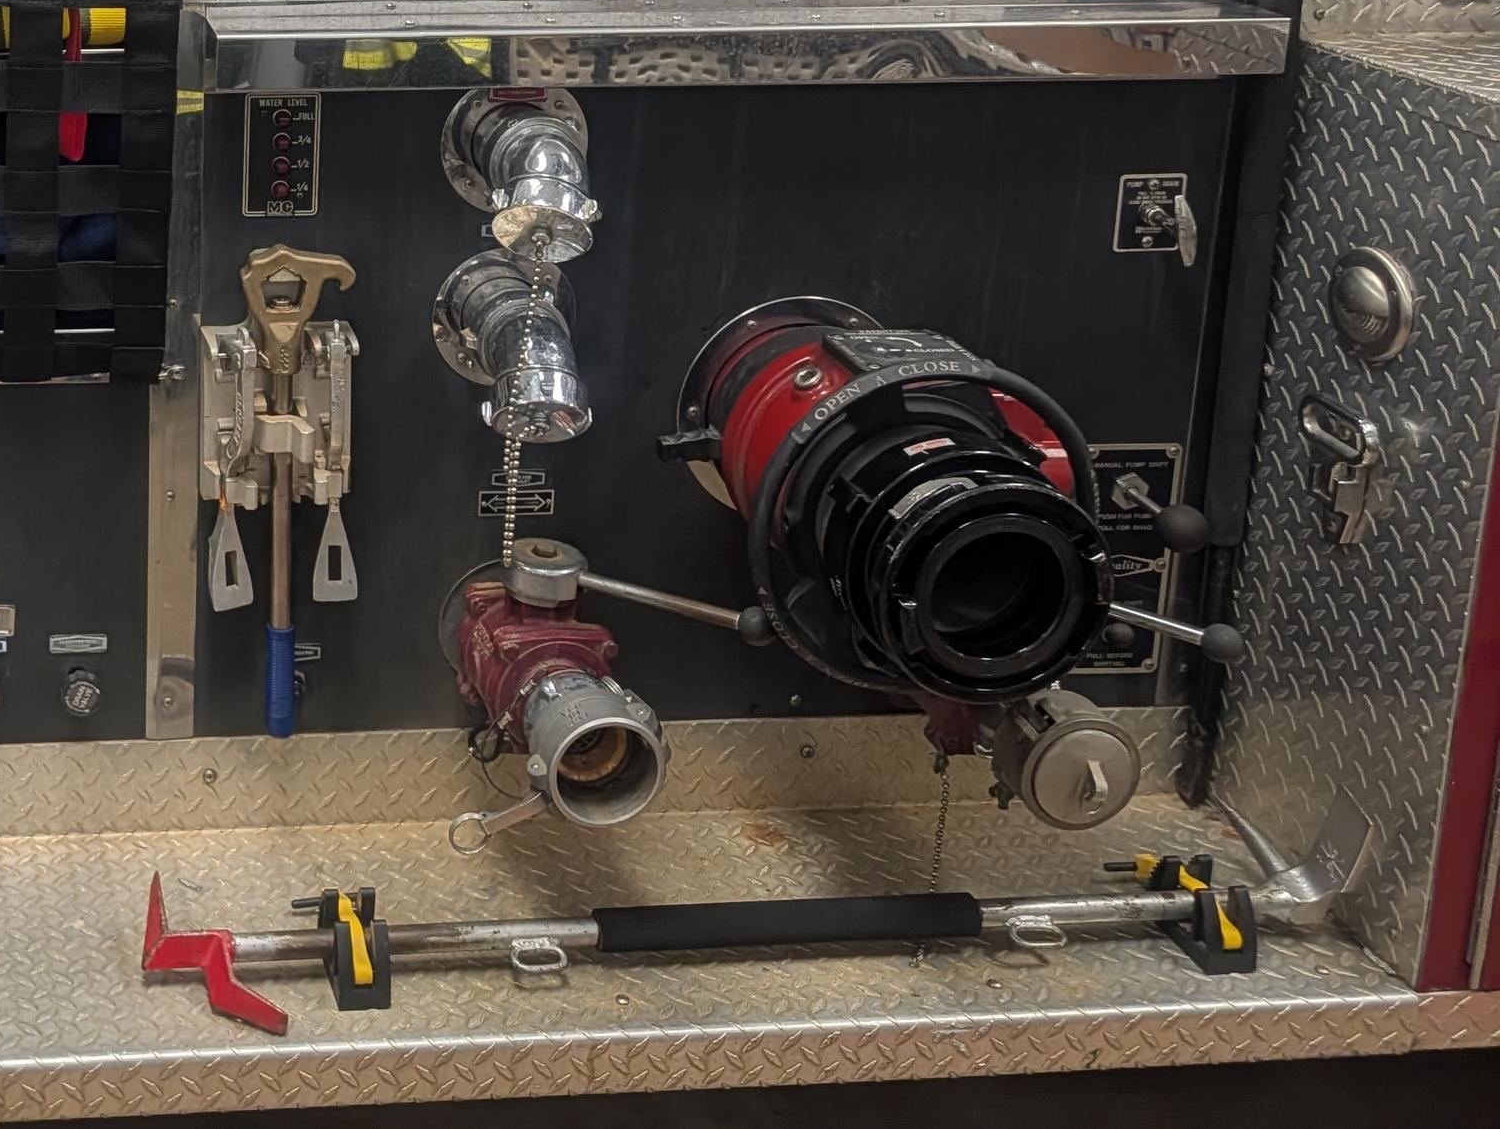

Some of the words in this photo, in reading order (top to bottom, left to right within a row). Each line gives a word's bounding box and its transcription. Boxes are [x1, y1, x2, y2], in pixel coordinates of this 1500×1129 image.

[298, 112, 314, 120] FULL
[298, 135, 311, 146] 3/4
[297, 158, 310, 169] 1/2
[297, 182, 308, 192] 1/4
[814, 383, 863, 422] OPEN
[898, 360, 961, 377] CLOSE
[1112, 560, 1143, 572] ality
